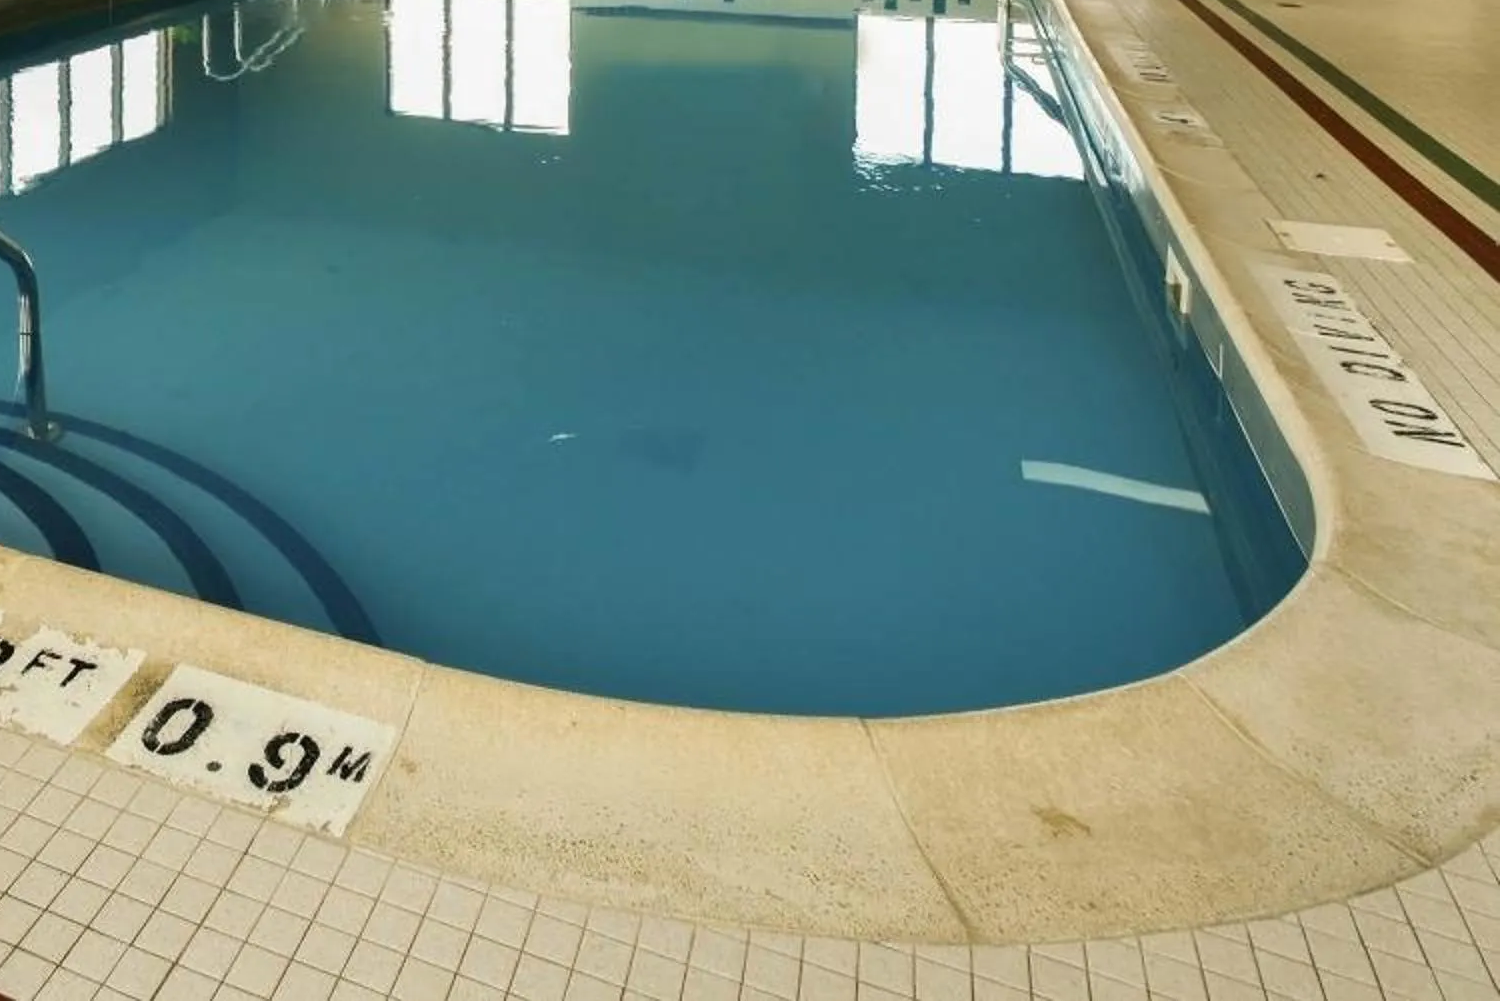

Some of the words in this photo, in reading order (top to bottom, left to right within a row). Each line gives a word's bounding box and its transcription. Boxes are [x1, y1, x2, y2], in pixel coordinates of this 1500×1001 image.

[1283, 278, 1409, 383] DIVING
[1368, 398, 1466, 448] NO
[20, 648, 98, 688] FT
[140, 697, 322, 794] 0.9
